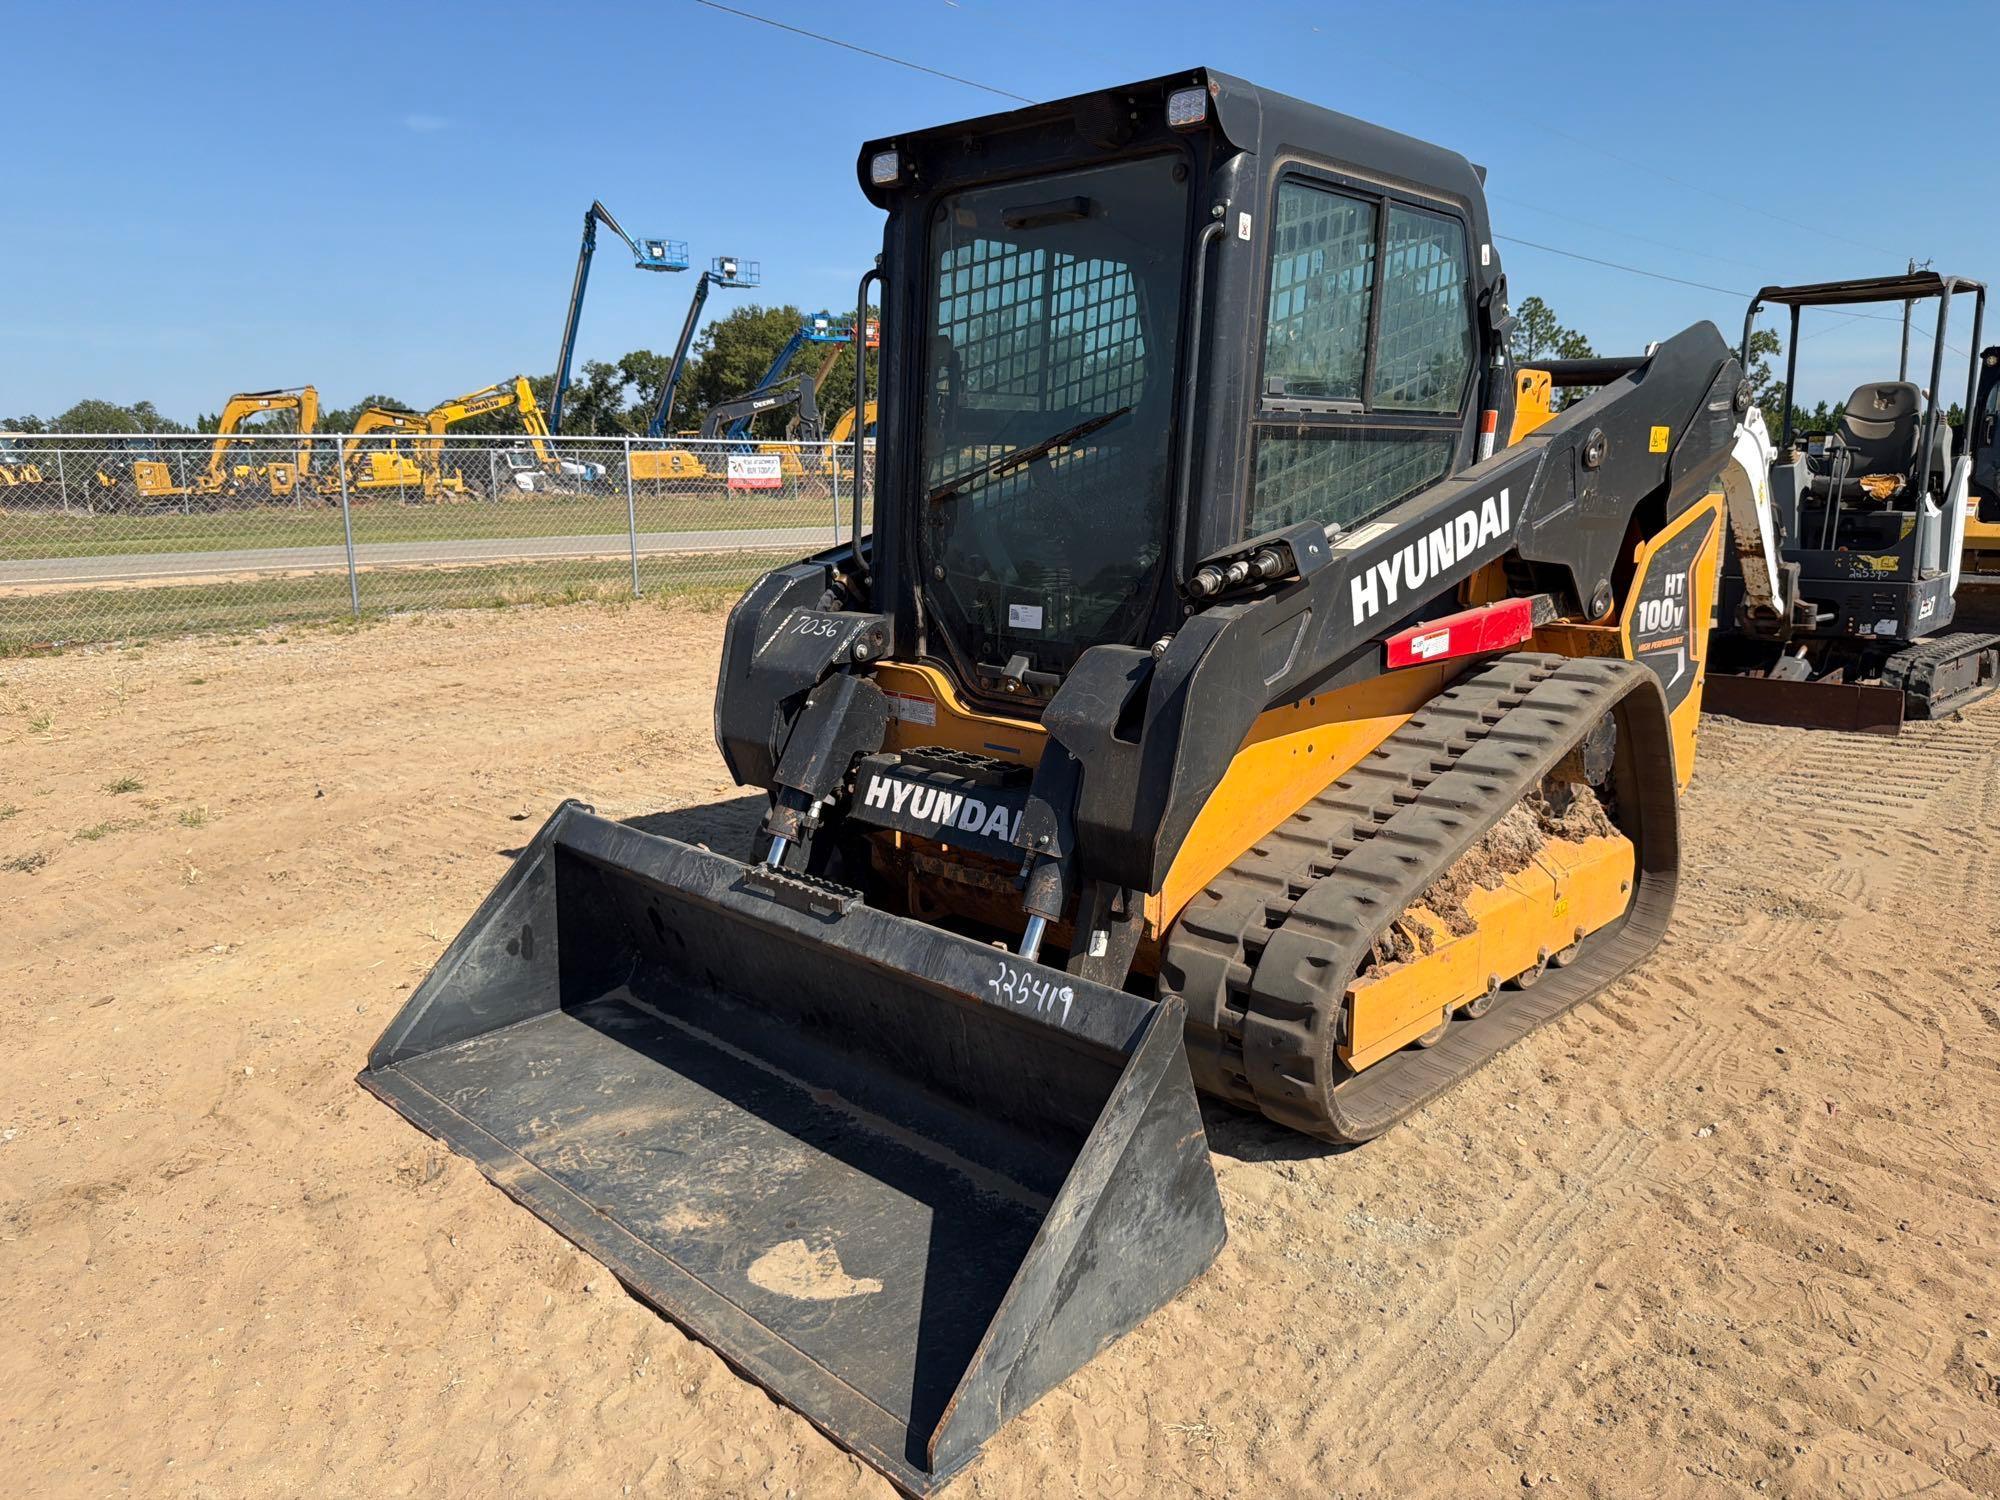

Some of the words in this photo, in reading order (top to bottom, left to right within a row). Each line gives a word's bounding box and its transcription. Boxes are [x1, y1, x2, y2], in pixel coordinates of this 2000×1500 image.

[753, 398, 775, 408] DEERE
[1350, 487, 1511, 627] HYUNDAI
[1664, 572, 1686, 597] HT
[790, 615, 844, 638] 7036
[1638, 642, 1652, 652] HIGH
[1651, 635, 1685, 649] PERFORMANCE
[864, 775, 1024, 844] HYUNDAI
[988, 961, 1074, 1027] 225419
